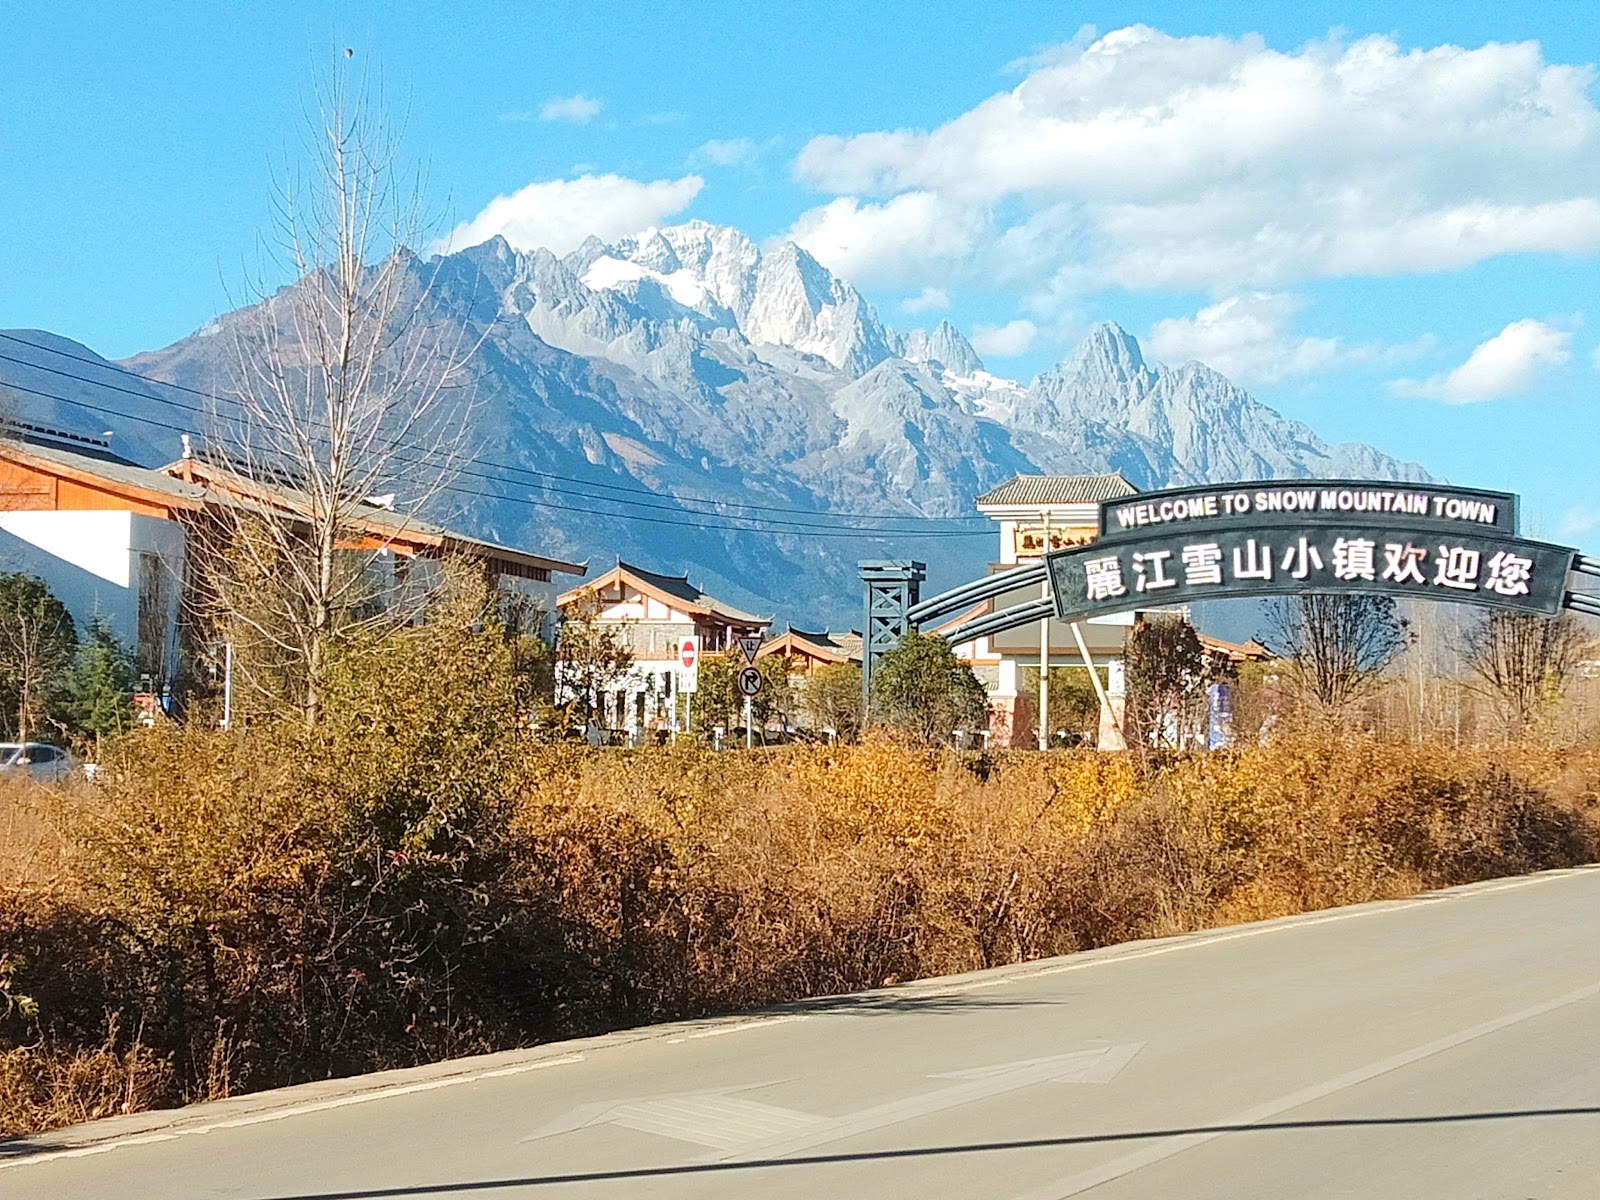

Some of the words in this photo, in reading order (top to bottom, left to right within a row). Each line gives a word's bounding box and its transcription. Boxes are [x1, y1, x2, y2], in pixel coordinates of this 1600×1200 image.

[1116, 495, 1218, 528] WELCOME
[1221, 493, 1250, 514] TO
[1255, 490, 1317, 512] SNOW
[1320, 490, 1428, 515] MOUNTAIN
[1433, 497, 1495, 524] TOWN
[1083, 537, 1533, 601] 麗江雪山小镇欢迎您
